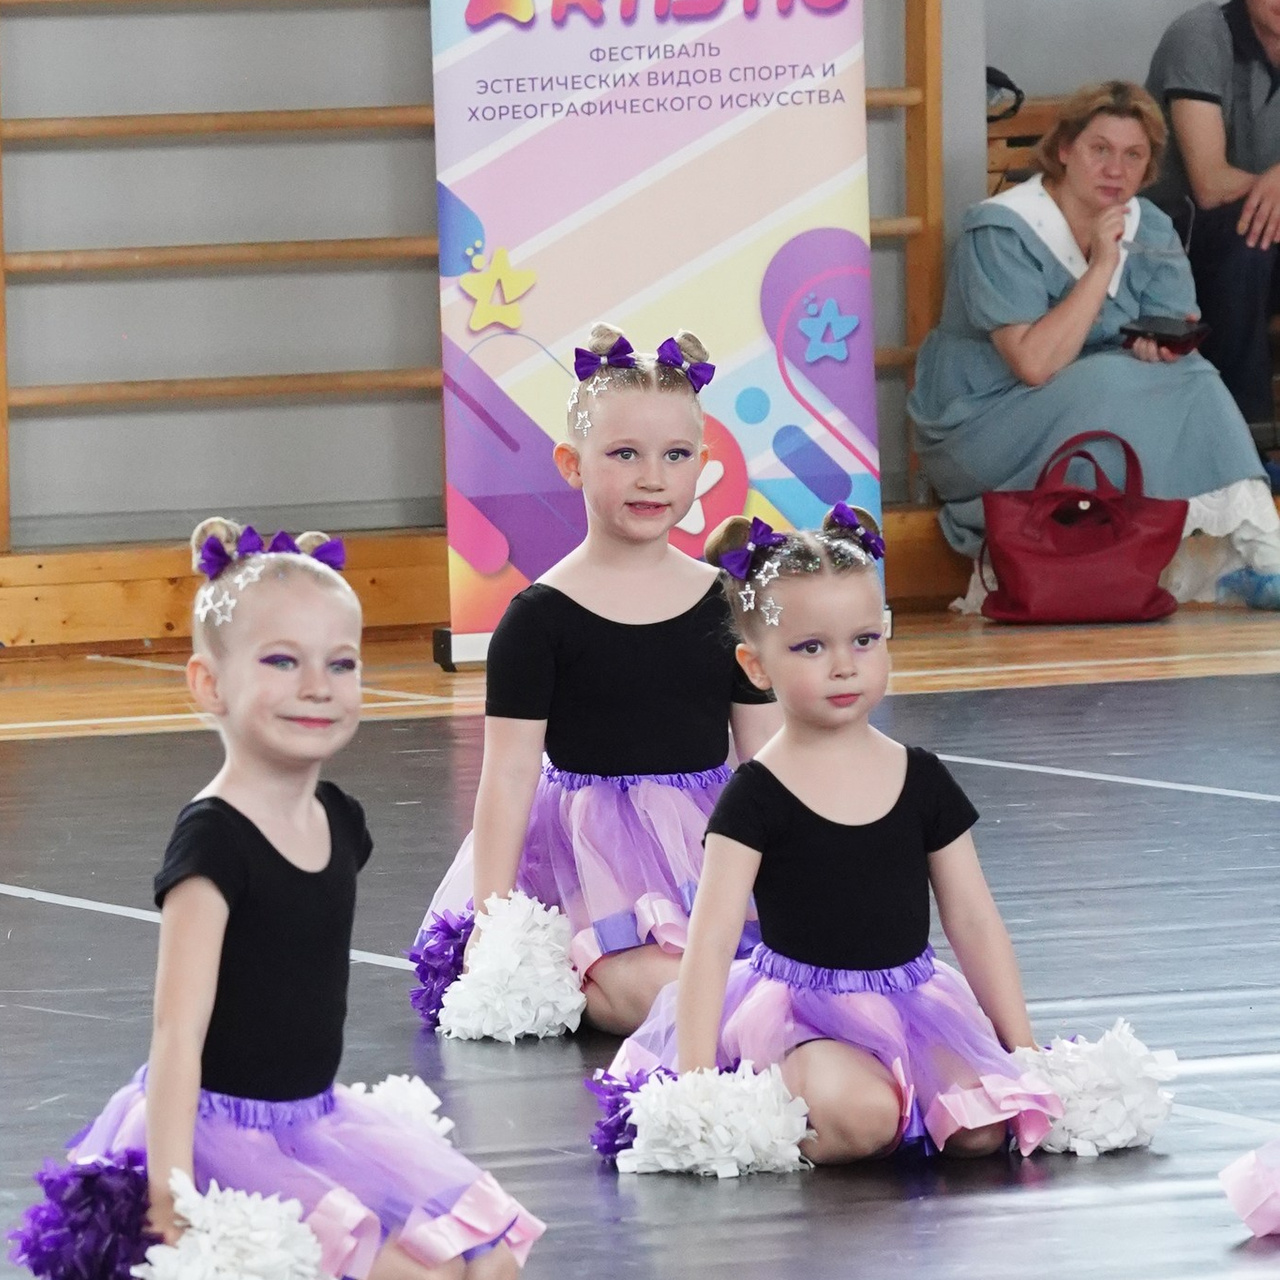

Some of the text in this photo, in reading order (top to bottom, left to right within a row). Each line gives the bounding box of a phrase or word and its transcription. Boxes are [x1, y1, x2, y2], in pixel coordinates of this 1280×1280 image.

[589, 42, 721, 63] ФЕСТИВАЛЬ
[475, 62, 836, 95] ЭСТЕТИЧЕСКИХ ВИДОВ СПОРТА И
[467, 89, 846, 122] ХОРЕОГРАФИЧЕСКОГО ИСКУССТВА
